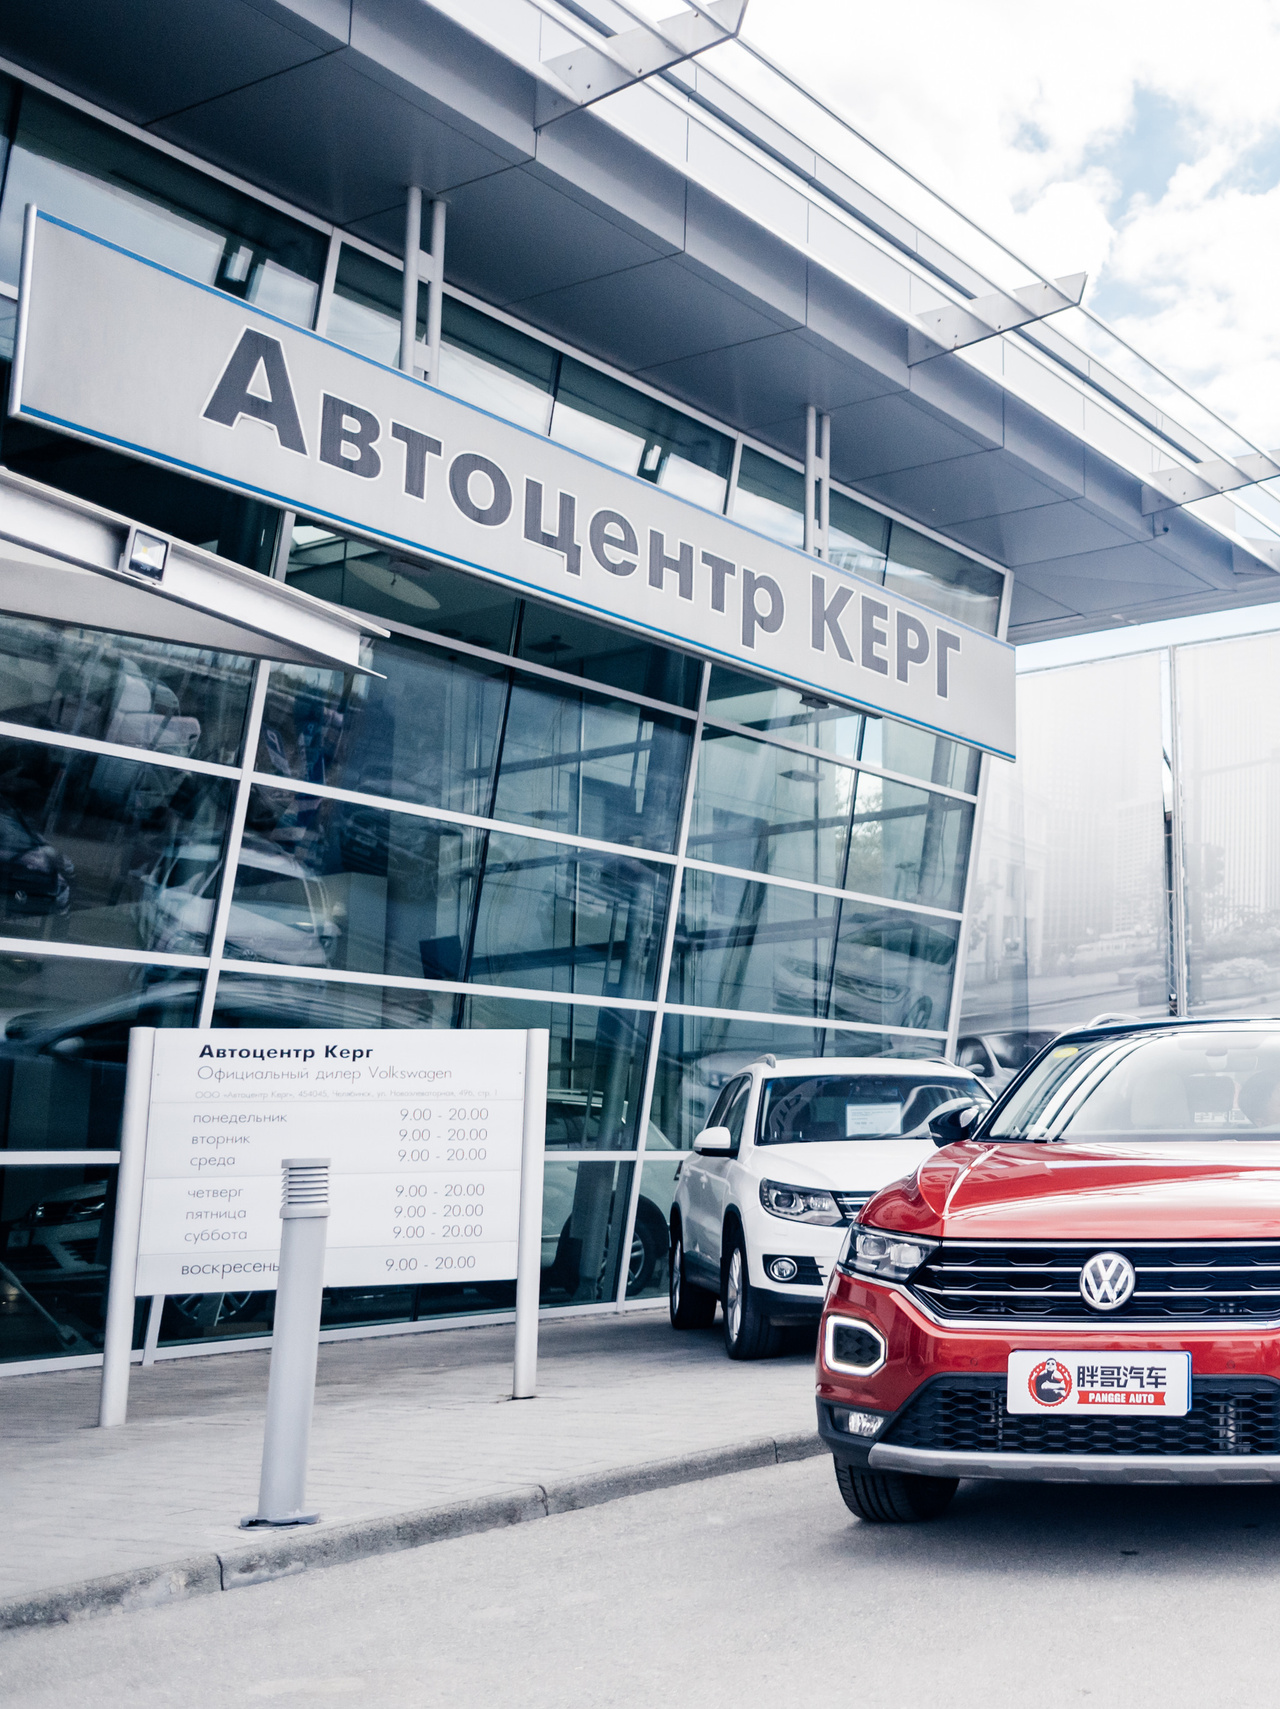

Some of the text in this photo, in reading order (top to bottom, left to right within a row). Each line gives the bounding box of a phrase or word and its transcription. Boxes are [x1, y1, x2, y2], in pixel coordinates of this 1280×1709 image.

[199, 324, 962, 700] Автоцентр КЕРГ
[199, 1044, 373, 1062] Автоцентр Керг
[197, 1065, 452, 1084] Официальный дилер Volkswagen
[193, 1114, 288, 1124] понедельник
[400, 1108, 432, 1121] 9.00
[448, 1107, 489, 1121] 20.00
[191, 1135, 250, 1149] вторник
[399, 1128, 431, 1142] 9.00
[447, 1127, 488, 1141] 20.00
[398, 1149, 430, 1162] 9.00
[446, 1147, 487, 1161] 20.00
[190, 1156, 236, 1170] среда
[187, 1188, 244, 1202] четверг
[395, 1184, 428, 1197] 9.00
[444, 1183, 485, 1197] 20.00
[185, 1209, 247, 1220] пятница
[394, 1205, 426, 1218] 9.00
[443, 1203, 484, 1217] 20.00
[184, 1229, 248, 1244] суббота
[392, 1225, 425, 1239] 9.00
[442, 1224, 483, 1238] 20.00
[385, 1258, 418, 1271] 9.00
[435, 1255, 476, 1270] 20.00
[181, 1262, 280, 1280] воскресень
[1077, 1365, 1167, 1388] 胖哥汽车
[1088, 1392, 1155, 1404] PANGGE AUTO
